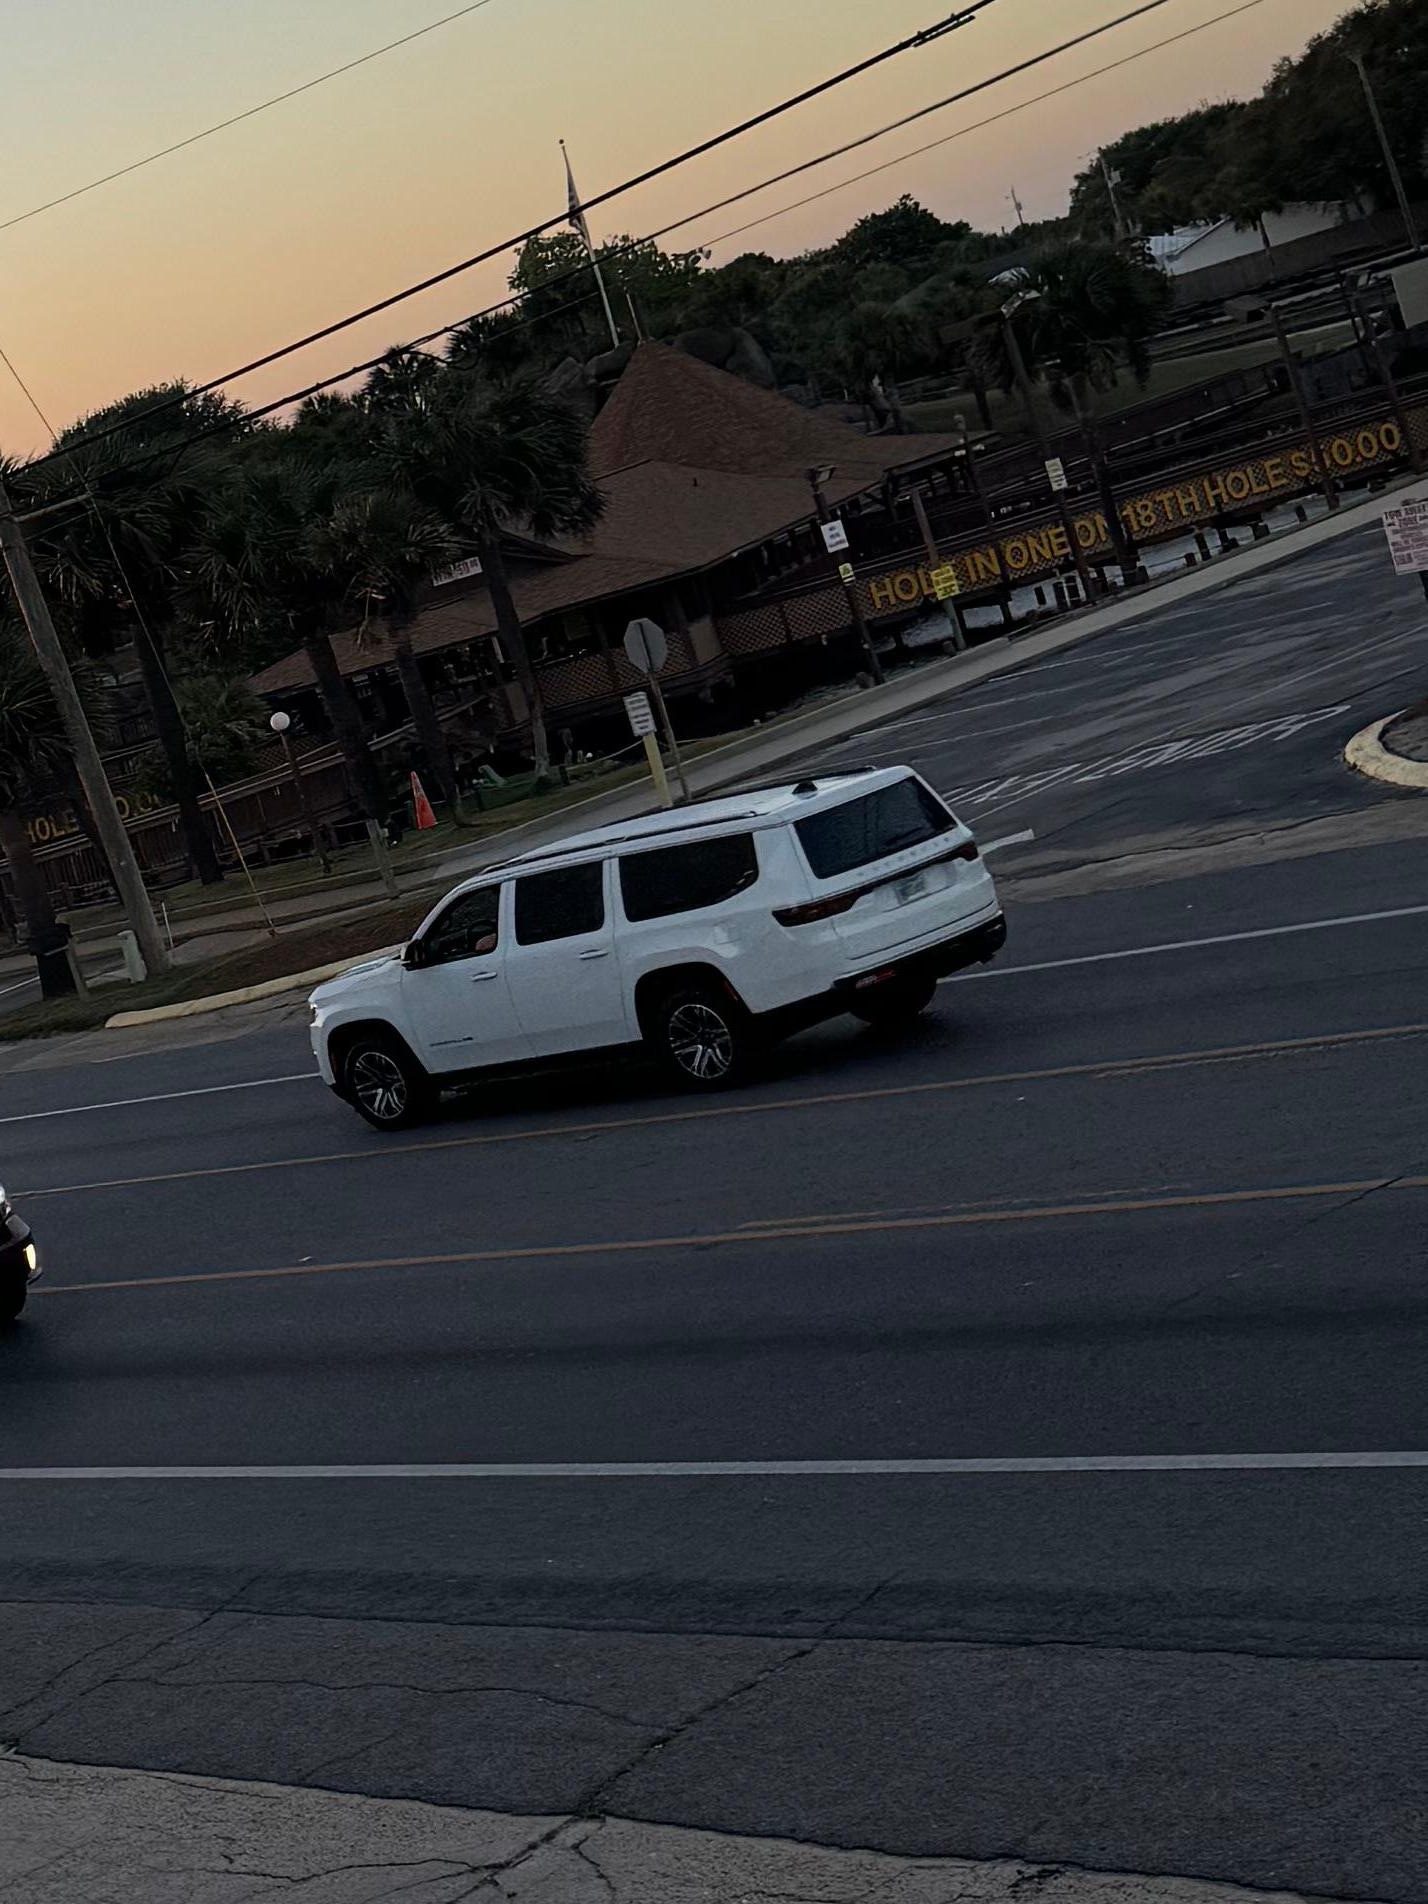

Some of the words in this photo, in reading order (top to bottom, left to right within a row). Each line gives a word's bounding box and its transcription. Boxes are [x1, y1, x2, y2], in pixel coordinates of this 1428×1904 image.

[869, 567, 935, 610] HOL
[964, 547, 1001, 583] IN
[1005, 526, 1072, 570] ONE
[1121, 484, 1202, 533] 18TH
[1203, 458, 1289, 509] HOLE
